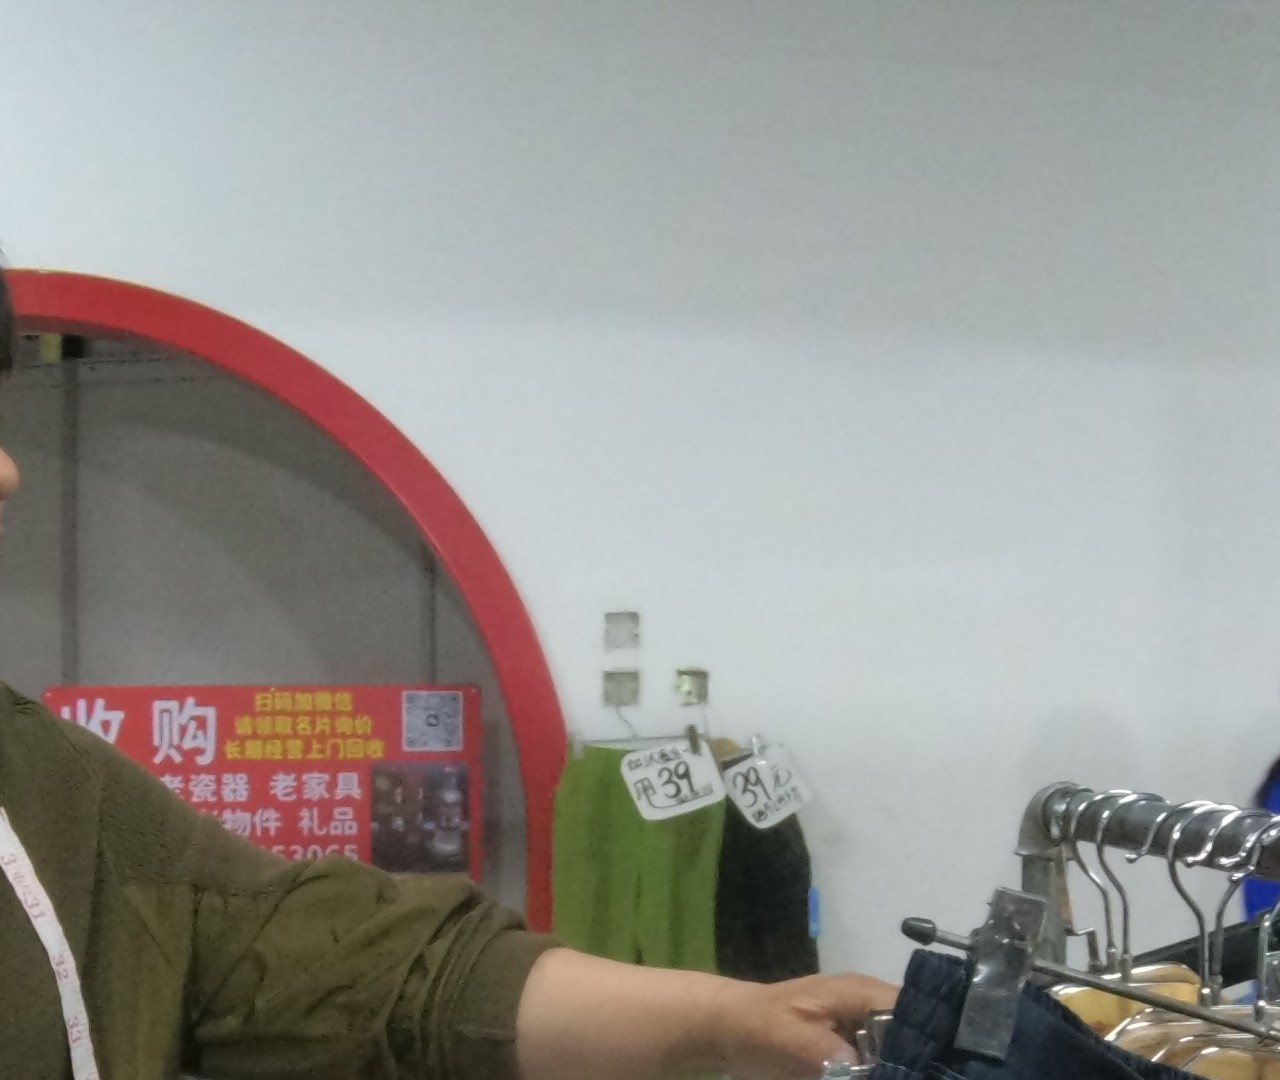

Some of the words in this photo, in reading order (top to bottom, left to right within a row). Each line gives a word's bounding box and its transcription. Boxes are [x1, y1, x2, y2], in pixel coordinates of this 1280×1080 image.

[225, 738, 385, 760] 长期经营上门回收
[270, 772, 362, 801] 老家具
[298, 806, 359, 837] 礼品
